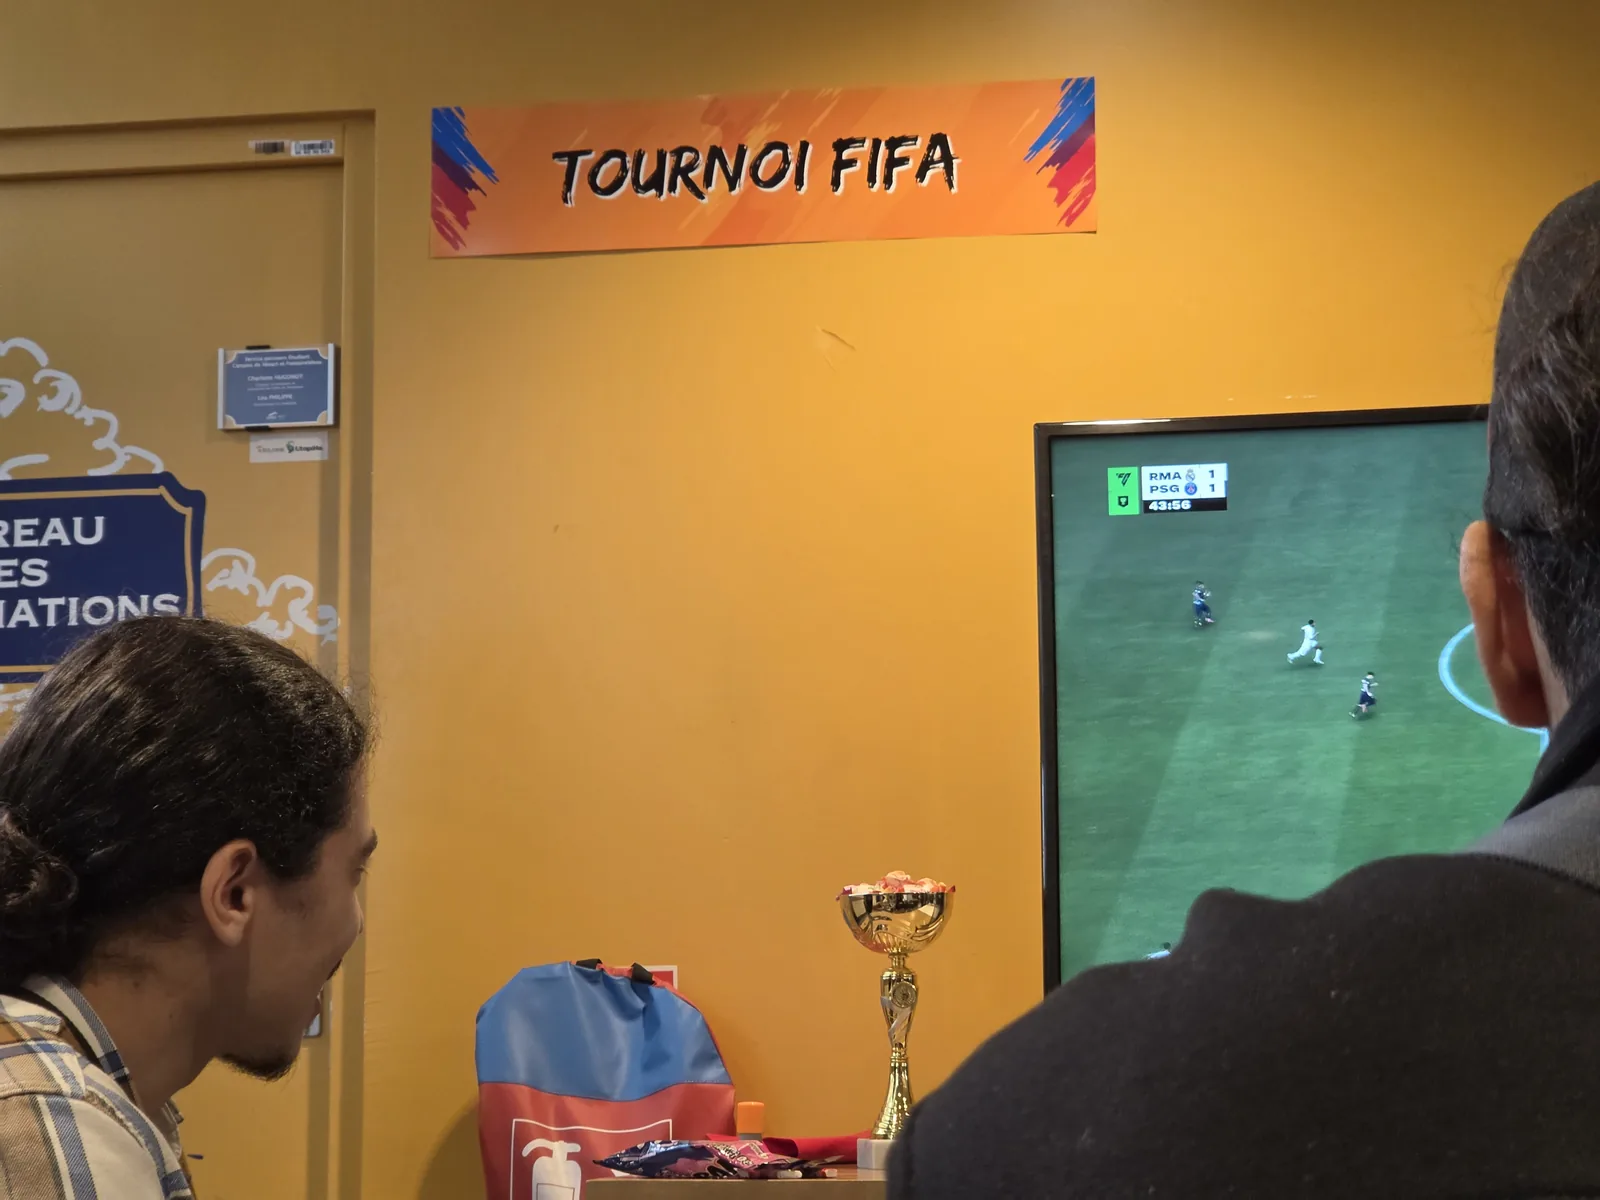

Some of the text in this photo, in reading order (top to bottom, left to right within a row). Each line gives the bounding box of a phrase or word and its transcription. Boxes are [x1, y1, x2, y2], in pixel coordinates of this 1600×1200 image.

[552, 132, 962, 207] TOURNOI FIFA
[1149, 469, 1215, 481] RMA 1
[1149, 483, 1215, 494] PSG 1
[1148, 500, 1192, 511] 43:56
